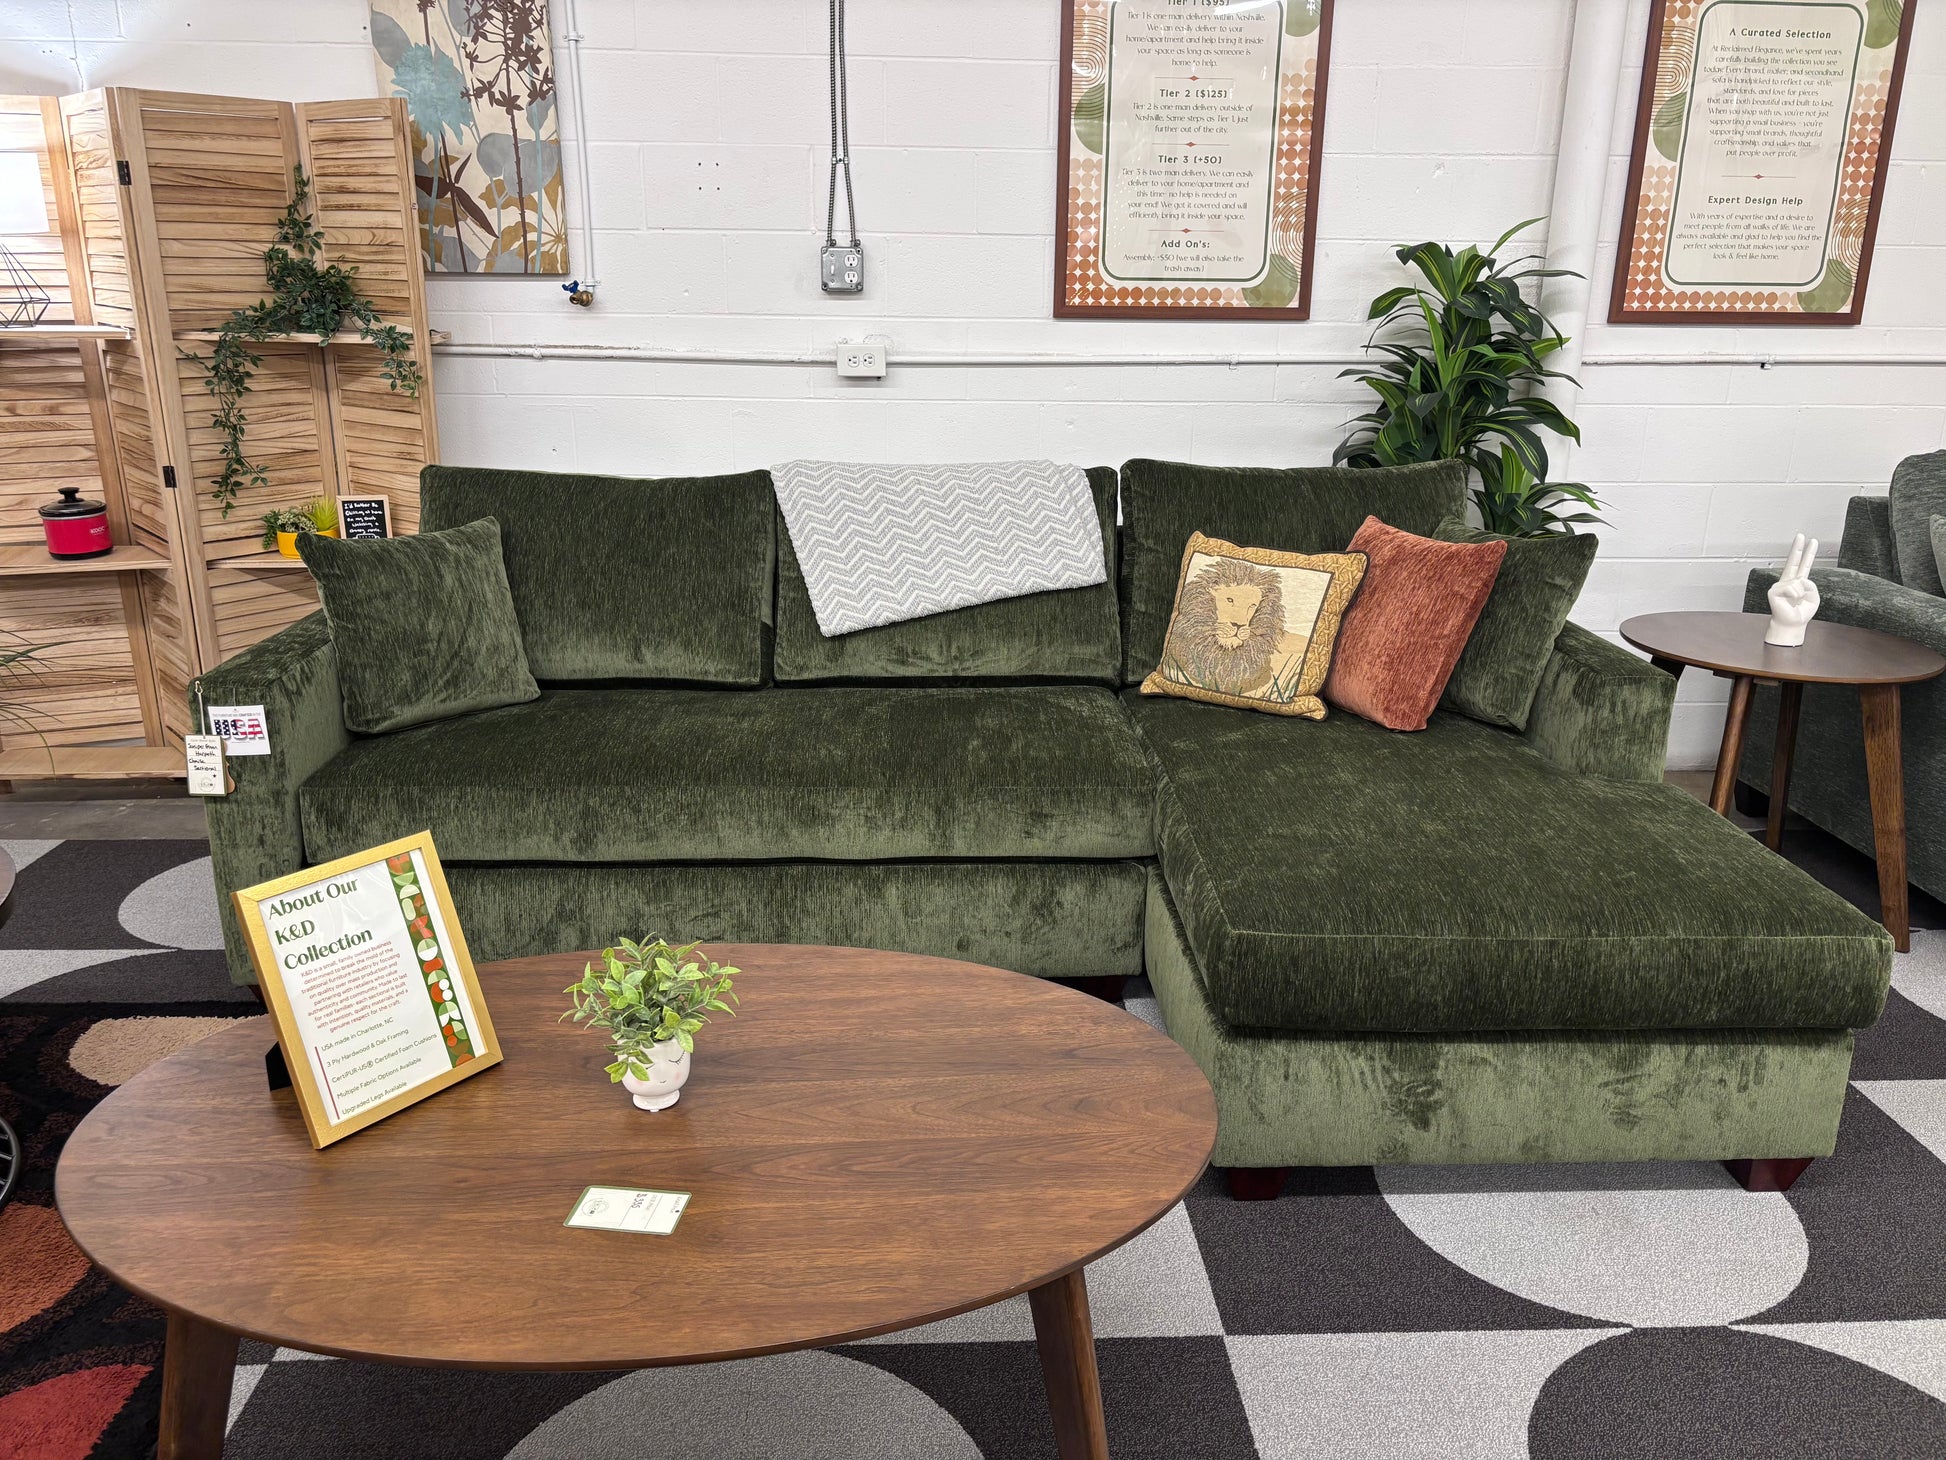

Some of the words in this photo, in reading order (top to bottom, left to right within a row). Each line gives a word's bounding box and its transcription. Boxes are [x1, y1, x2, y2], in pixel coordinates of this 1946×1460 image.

[1730, 28, 1736, 36] A
[1741, 28, 1781, 37] Curated
[1786, 29, 1831, 39] Selection
[1160, 89, 1180, 97] Tier
[1185, 89, 1190, 98] 2
[1158, 155, 1178, 163] Tier
[1183, 155, 1188, 164] 3
[1708, 195, 1740, 205] Expert
[1745, 196, 1777, 206] Design
[1782, 196, 1803, 206] Help
[1161, 239, 1180, 248] Add
[1185, 240, 1210, 248] On's:
[214, 718, 265, 740] USA
[269, 890, 324, 920] About
[326, 879, 358, 898] Our
[275, 919, 315, 945] K&D
[284, 929, 373, 970] Collection
[321, 1043, 334, 1051] USA
[335, 1037, 350, 1046] made
[357, 1023, 384, 1036] Charlotte,
[332, 1058, 340, 1066] Ply
[341, 1045, 370, 1060] Hardwood
[387, 1028, 409, 1041] Framing
[375, 1050, 399, 1064] Certified
[399, 1044, 414, 1053] Foam
[414, 1033, 437, 1047] Cushions
[337, 1086, 359, 1099] Multiple
[360, 1078, 377, 1089] Fabric
[378, 1068, 399, 1081] Options
[400, 1057, 422, 1071] Available
[342, 1098, 370, 1115] Upgraded
[371, 1092, 384, 1102] Legs
[385, 1081, 407, 1095] Available
